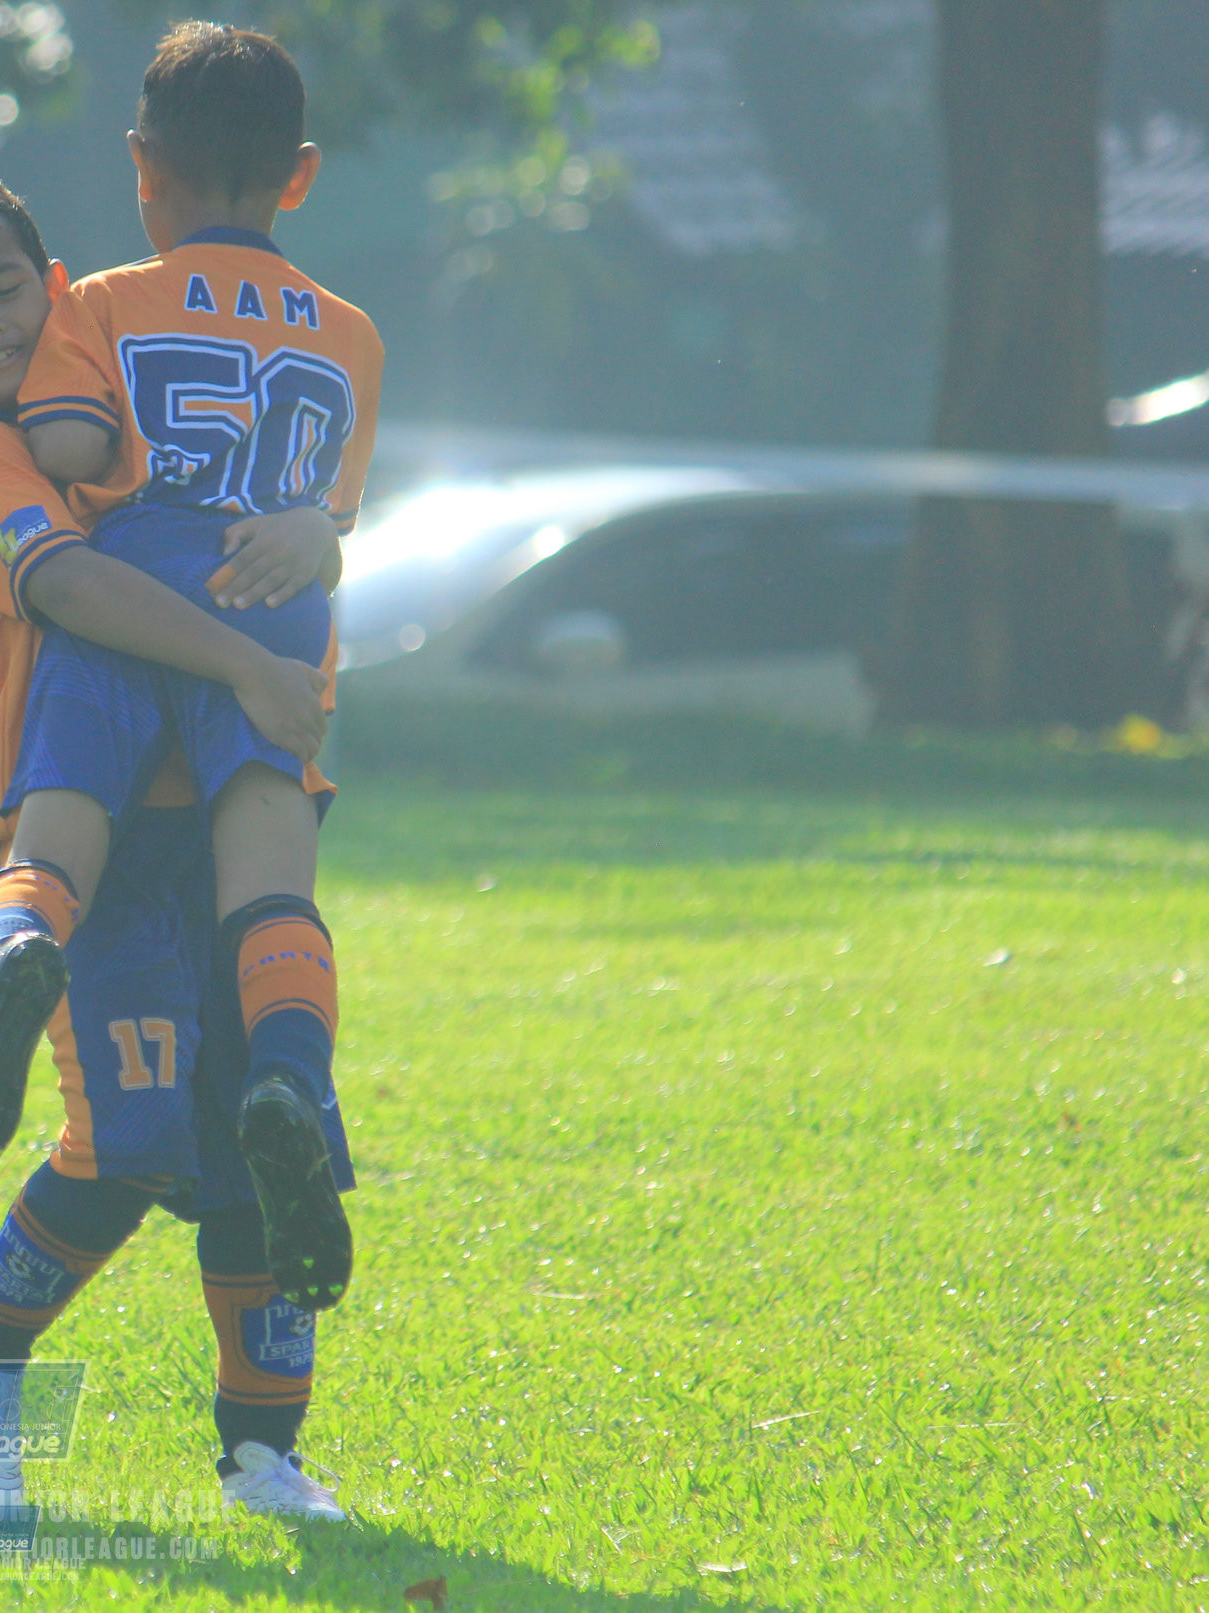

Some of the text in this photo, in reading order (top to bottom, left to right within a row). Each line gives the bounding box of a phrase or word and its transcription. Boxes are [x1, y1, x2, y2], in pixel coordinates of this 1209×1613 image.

[185, 274, 320, 330] AAM
[116, 333, 356, 515] 50
[109, 1017, 176, 1091] 17
